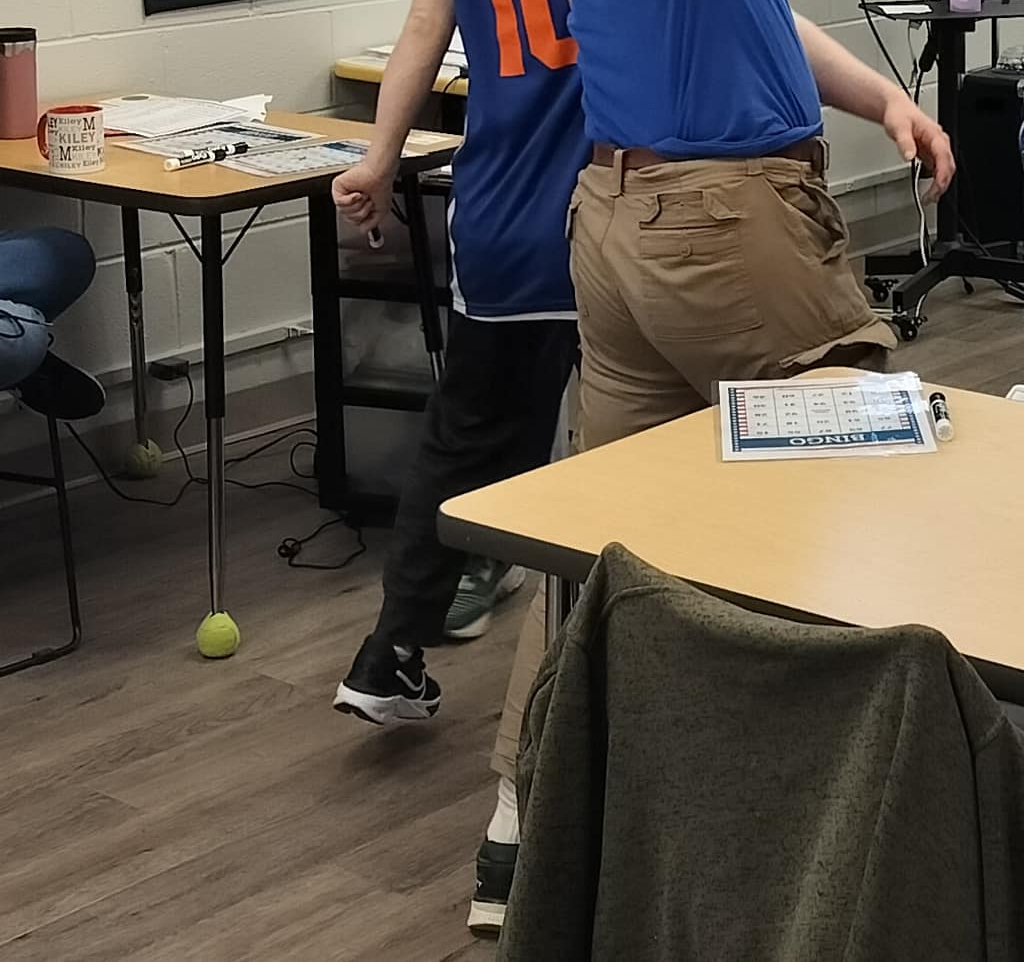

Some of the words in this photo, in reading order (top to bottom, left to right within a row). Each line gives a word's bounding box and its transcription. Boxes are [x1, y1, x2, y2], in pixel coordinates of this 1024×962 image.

[83, 116, 96, 131] M
[59, 132, 96, 144] KILEY
[59, 146, 72, 161] M
[789, 433, 866, 446] BINGO
